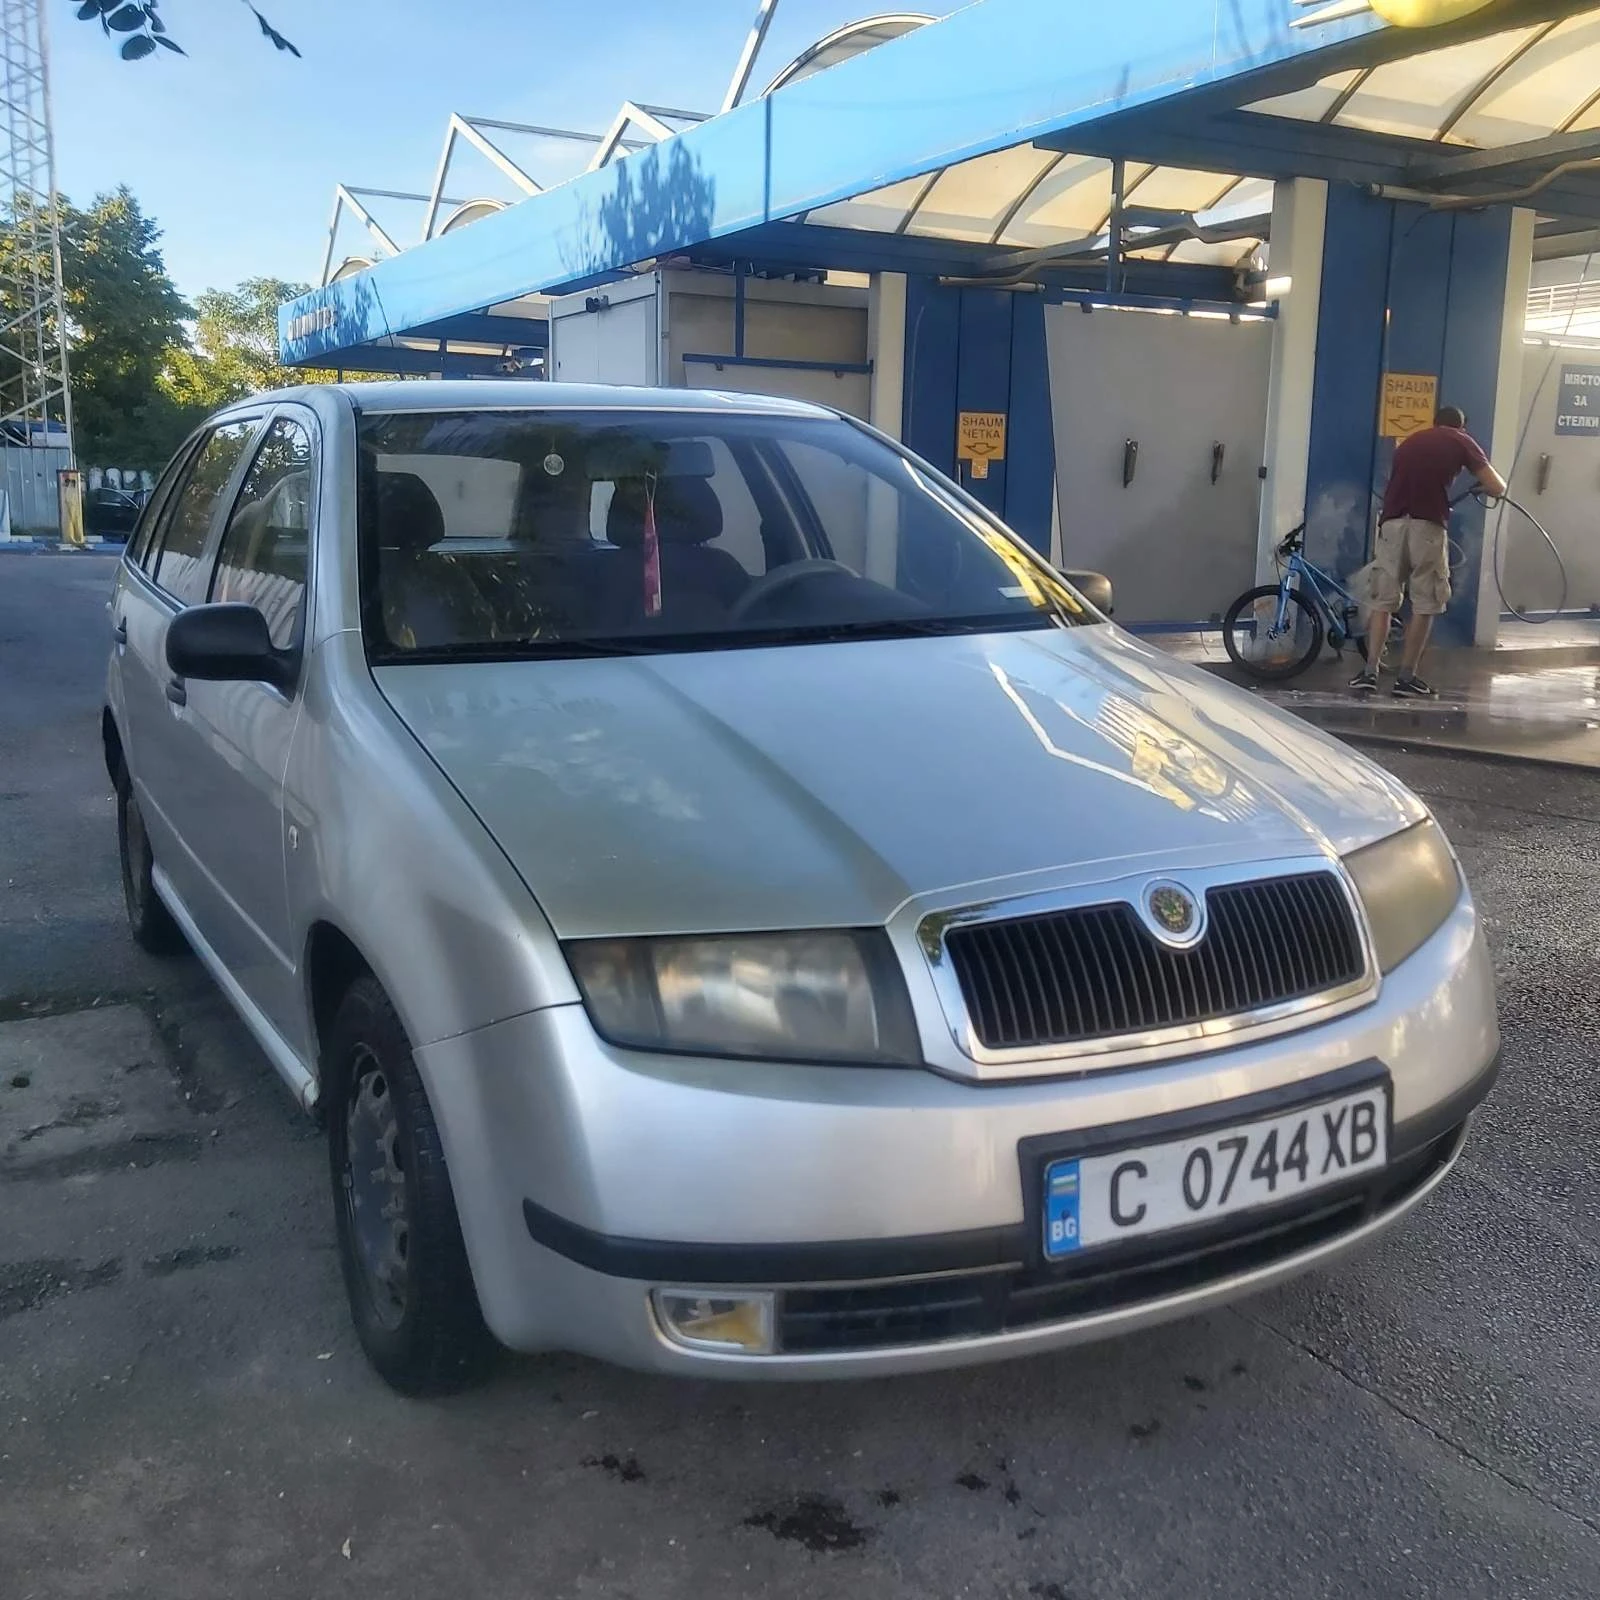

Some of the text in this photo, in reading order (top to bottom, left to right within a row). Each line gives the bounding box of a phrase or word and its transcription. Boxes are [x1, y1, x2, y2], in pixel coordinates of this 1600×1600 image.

[1386, 379, 1434, 393] SHAUM
[1565, 373, 1600, 386] МЯСТО
[1386, 396, 1430, 409] ЧЕТКА
[1573, 394, 1588, 407] ЗА
[962, 416, 1004, 428] SHAUM
[962, 428, 1001, 439] ЧЕТКА
[1109, 1099, 1378, 1227] C 0744 XB
[1050, 1216, 1077, 1242] BG
